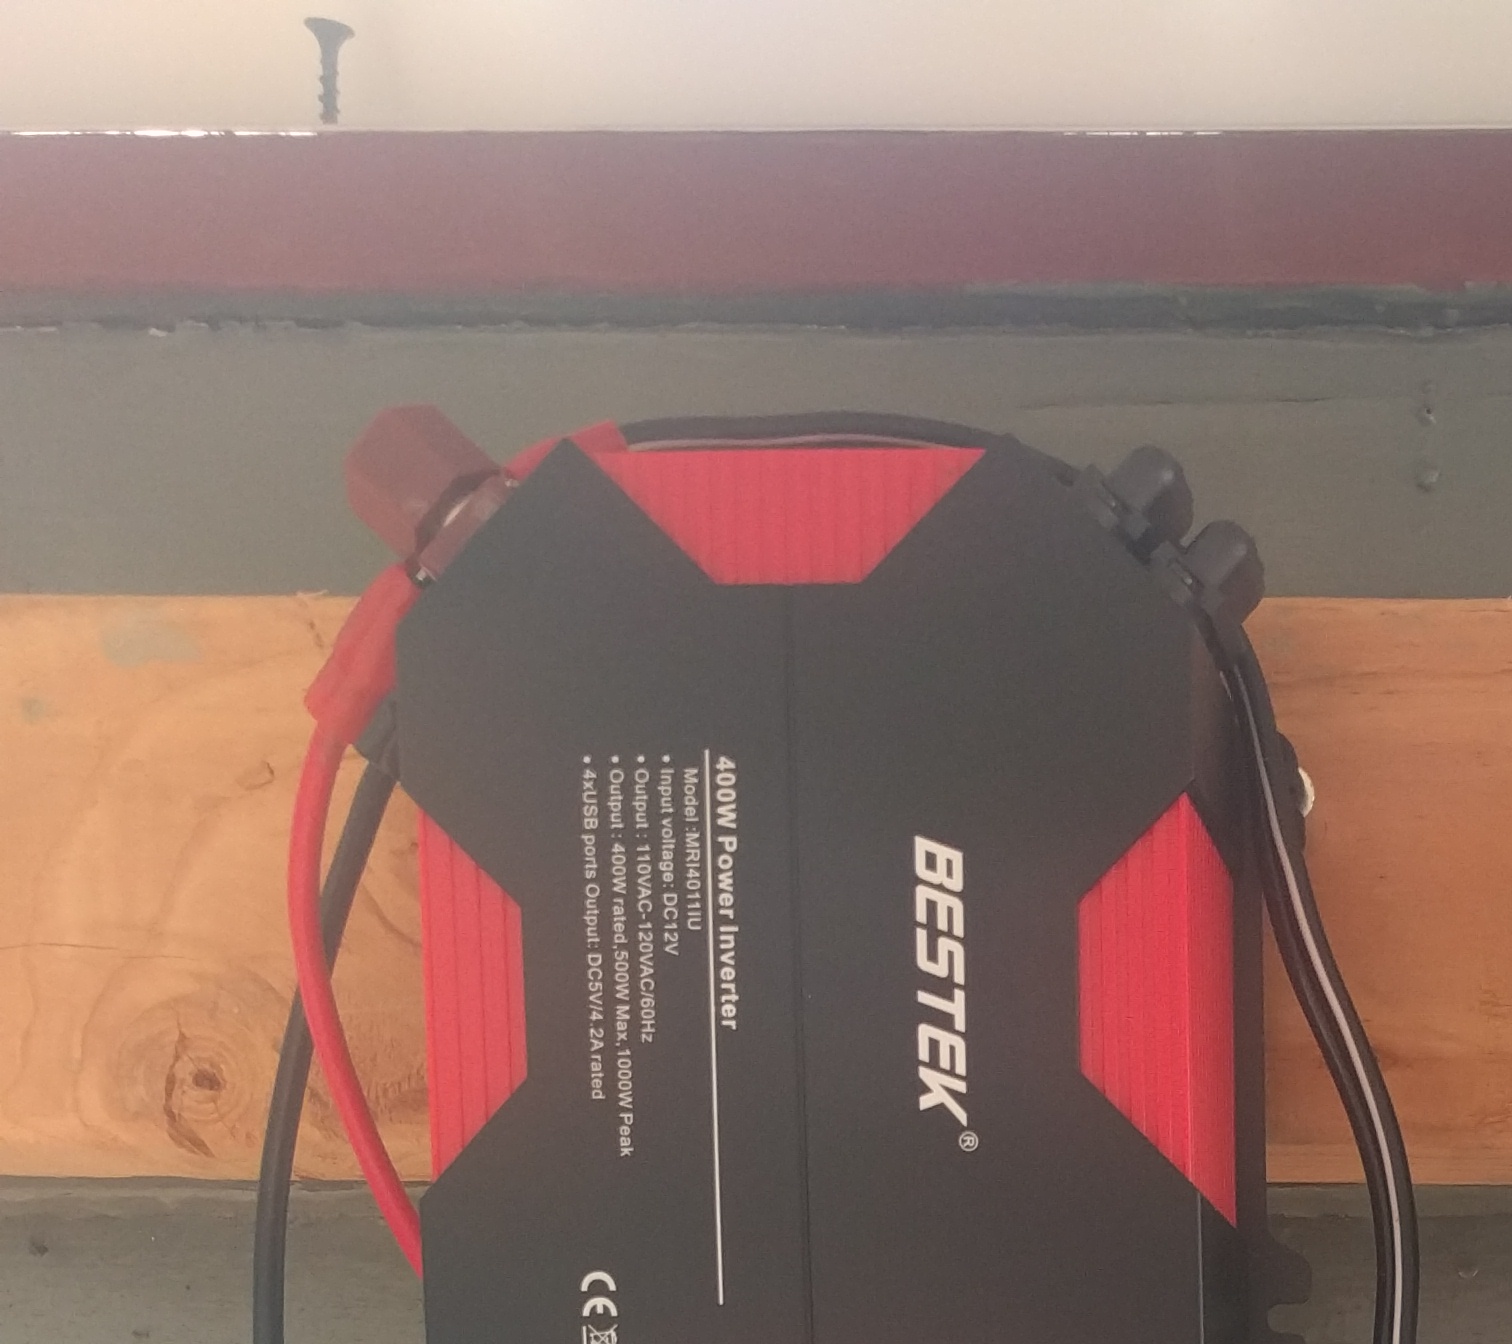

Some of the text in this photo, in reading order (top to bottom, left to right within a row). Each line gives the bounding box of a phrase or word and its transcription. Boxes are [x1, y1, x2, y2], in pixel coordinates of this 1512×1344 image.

[581, 769, 606, 1099] 4xUSB ports Output: DC5V/4.2A rated
[611, 842, 627, 894] 400W
[619, 1112, 634, 1156] Peak
[636, 844, 656, 1043] 110VAC-120VAC/60Hz
[657, 768, 679, 956] Input voltage: DC12V
[715, 756, 740, 1030] 400W Power Inverter
[914, 835, 968, 1128] BESTEK
[580, 1270, 618, 1317] CE
